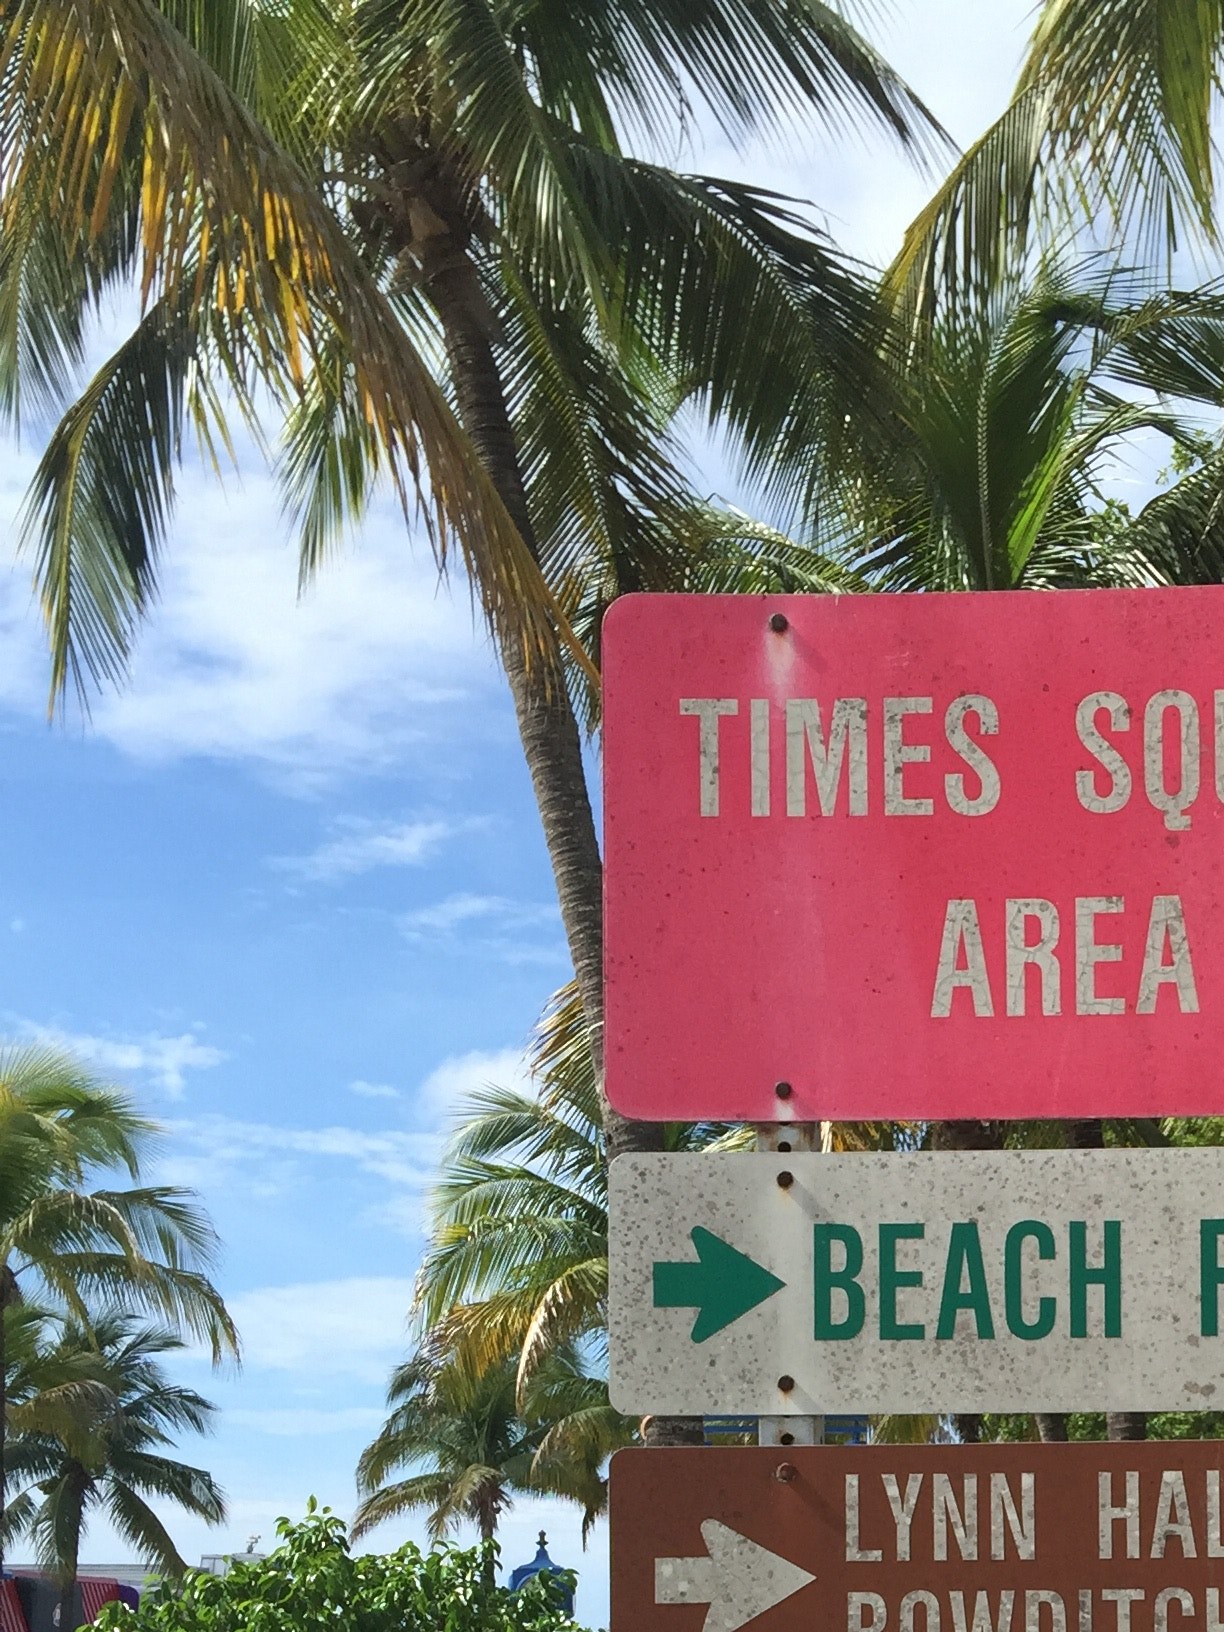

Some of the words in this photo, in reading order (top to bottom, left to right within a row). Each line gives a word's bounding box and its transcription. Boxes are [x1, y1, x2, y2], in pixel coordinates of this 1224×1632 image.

[679, 692, 1002, 820] TIMES
[930, 895, 1201, 1020] AREA
[814, 1219, 1122, 1341] BEACH
[845, 1472, 1036, 1562] LYNN
